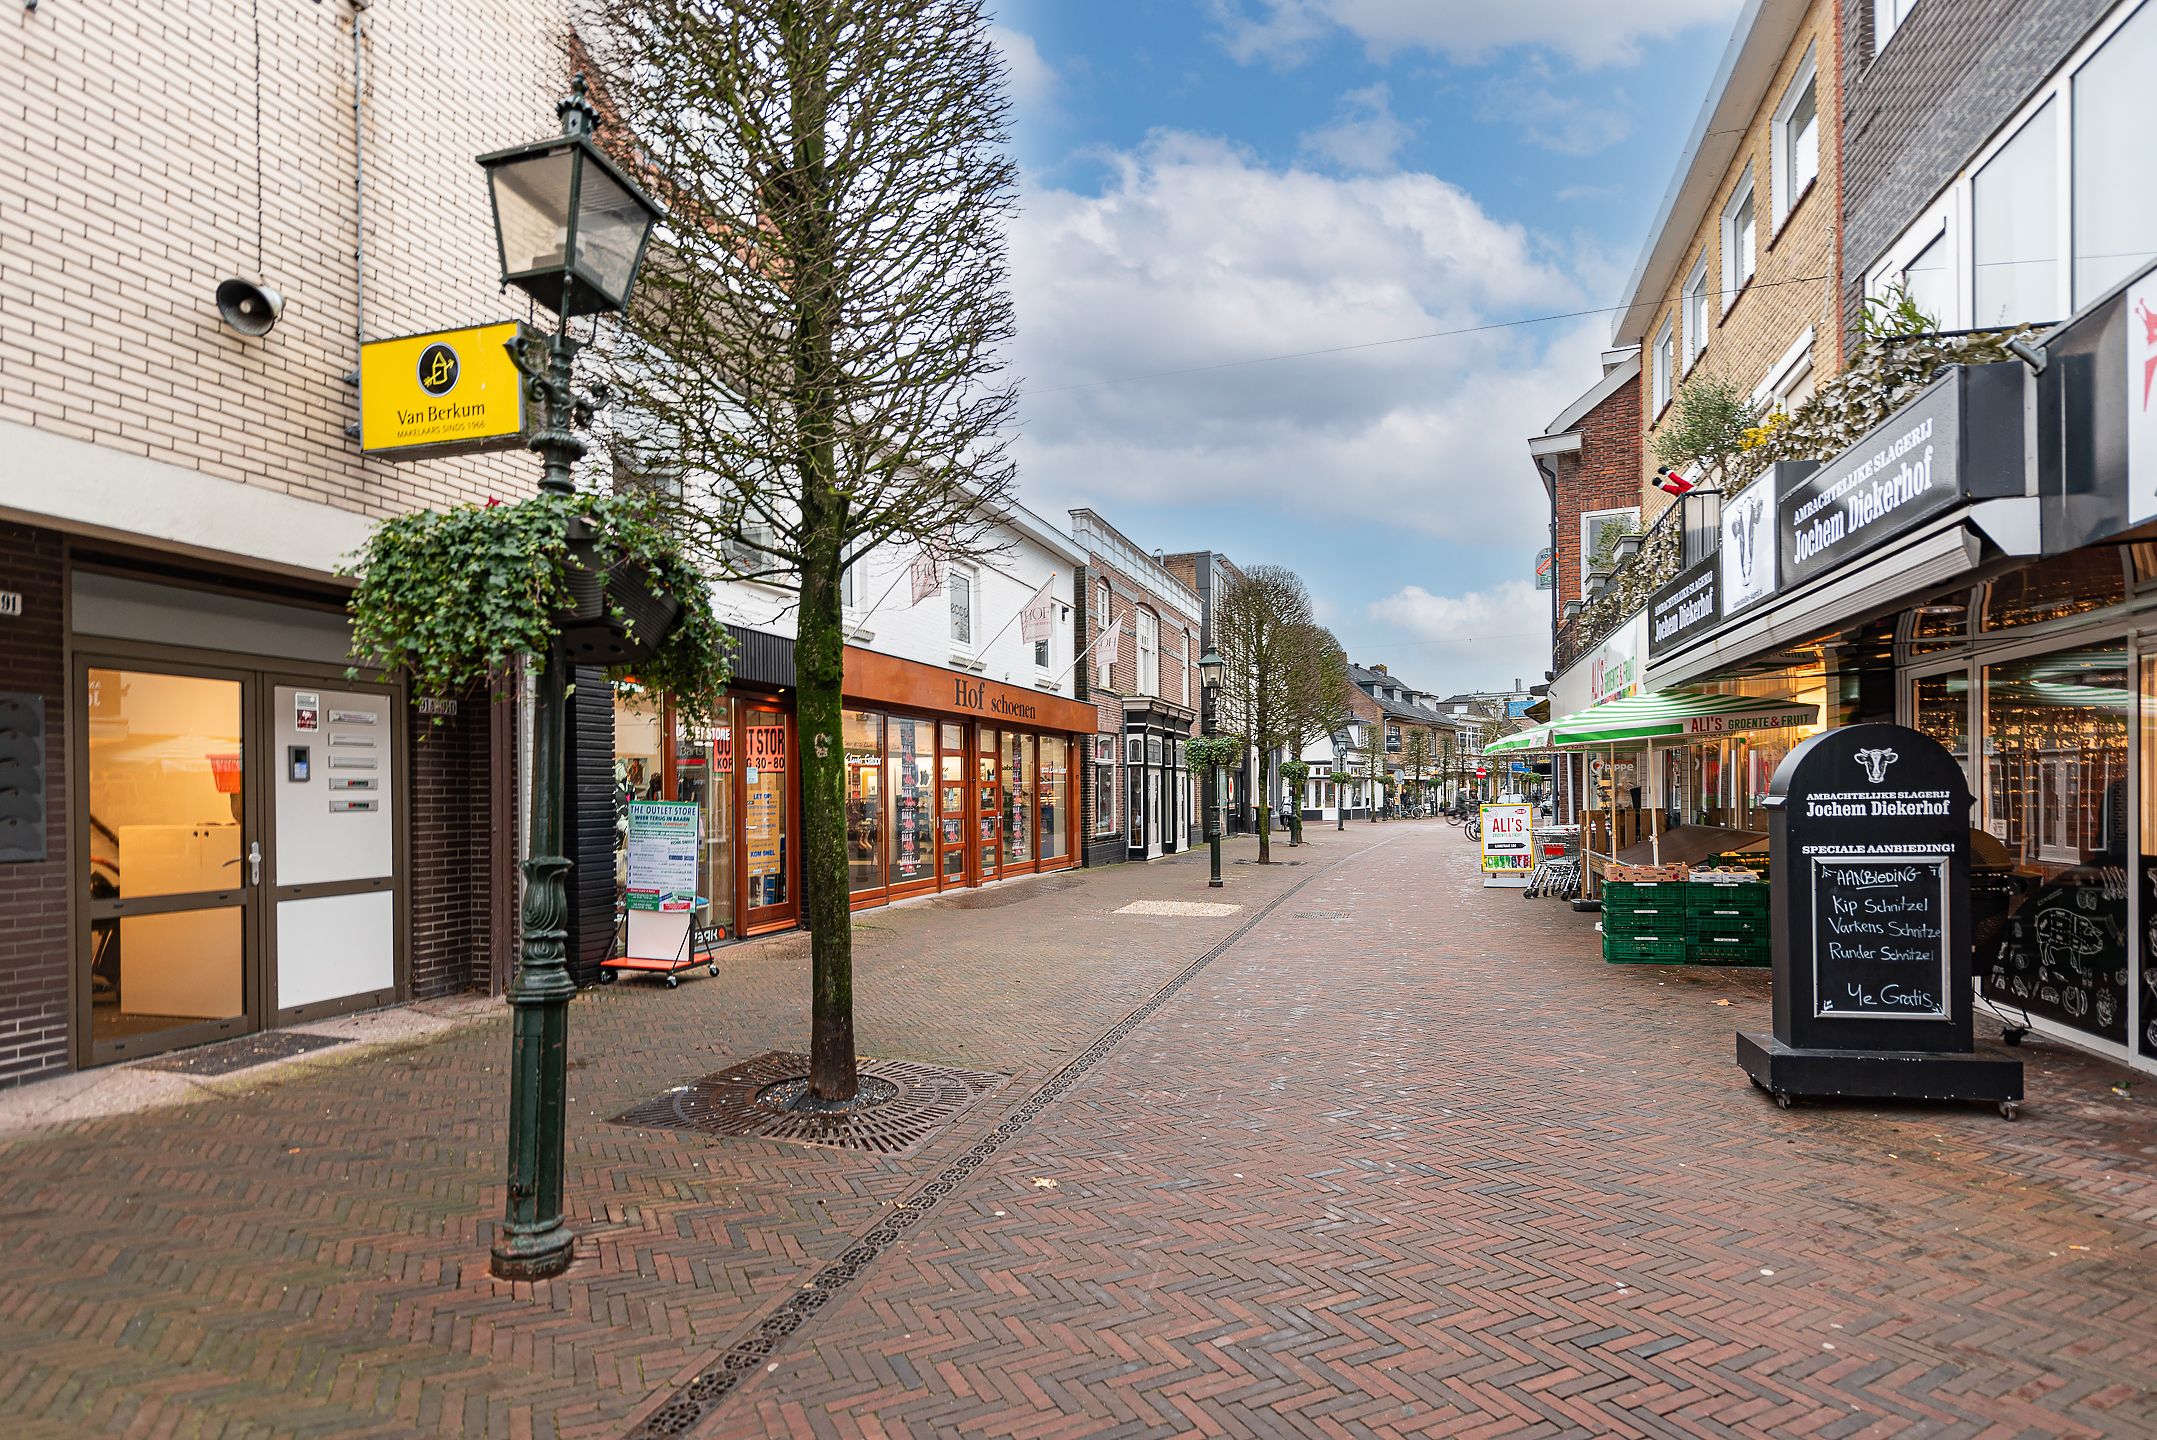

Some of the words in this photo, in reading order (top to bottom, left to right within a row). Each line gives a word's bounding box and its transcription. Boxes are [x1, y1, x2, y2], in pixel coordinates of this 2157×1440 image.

[397, 409, 424, 426] Van
[428, 402, 485, 422] Berkum
[397, 426, 441, 438] MAKELAARS
[442, 423, 465, 433] SINDS
[467, 420, 486, 430] 1966
[1793, 460, 1873, 526] AMBACHTELIJKE
[1873, 417, 1934, 473] SLAGERIJ
[1793, 510, 1845, 565] Jochem
[1847, 444, 1934, 534] Diekerhof
[1655, 613, 1679, 643] Jochem
[1679, 586, 1714, 630] Diekerhof
[1591, 657, 1604, 700] ALI'S
[1619, 663, 1623, 687] &
[1623, 655, 1635, 683] FRUIT
[954, 678, 986, 710] Hof
[991, 694, 1036, 719] schoenen
[706, 727, 731, 741] STORE
[1691, 716, 1723, 733] ALI'S
[1728, 717, 1770, 730] GROENTE
[1770, 716, 1780, 727] &
[1781, 714, 1810, 726] FRUIT
[757, 728, 785, 755] STOR
[1806, 791, 1897, 801] AMBACHTELIJKE
[1897, 790, 1951, 799] SLAGERIJ
[630, 805, 643, 814] THE
[645, 806, 673, 815] OUTLET
[674, 806, 696, 816] STORE
[1806, 801, 1867, 817] Jochem
[1870, 800, 1951, 816] Diekerhof
[1492, 817, 1522, 833] ALI'S
[1801, 845, 1866, 855] SPECIALE
[1866, 843, 1956, 854] AANBIEDING!
[1832, 895, 1858, 916] Kip
[1864, 896, 1928, 914] Schnitzel
[1828, 917, 1884, 934] Varkens
[1888, 921, 1942, 939] Schnitze
[1829, 942, 1877, 960] Runder
[1880, 946, 1934, 961] Schnitzel
[1880, 984, 1933, 1007] Gratis
